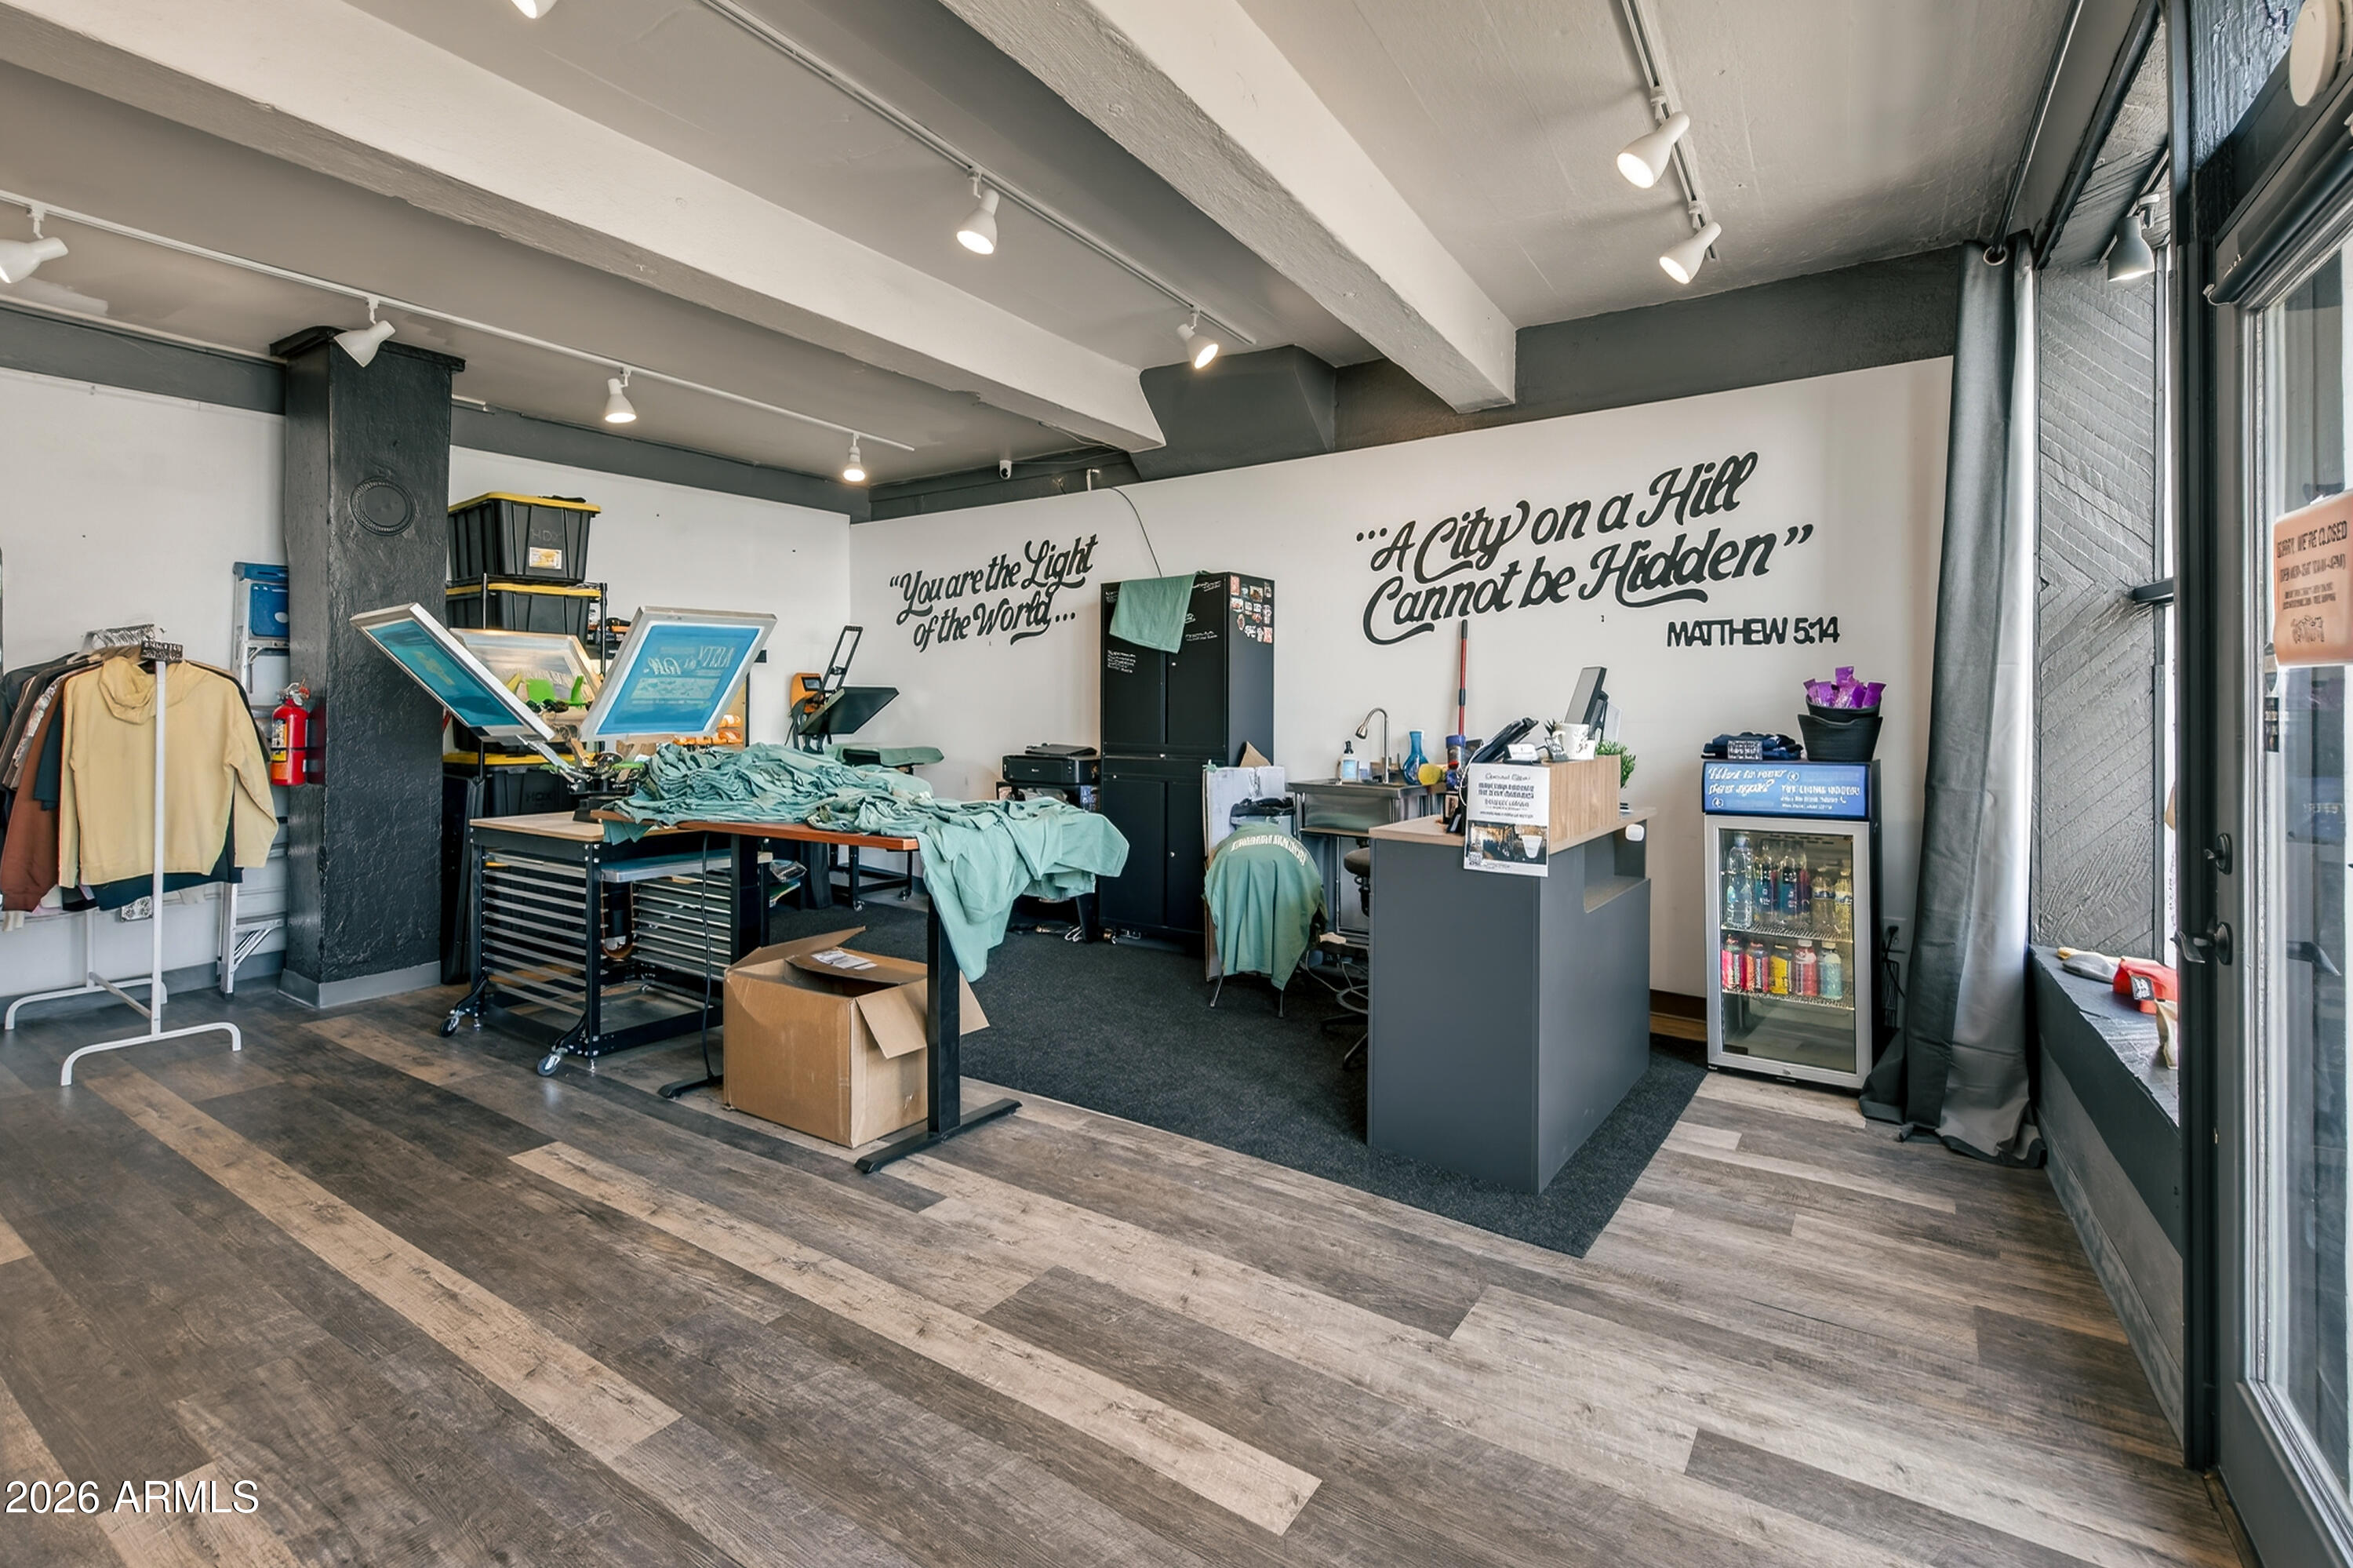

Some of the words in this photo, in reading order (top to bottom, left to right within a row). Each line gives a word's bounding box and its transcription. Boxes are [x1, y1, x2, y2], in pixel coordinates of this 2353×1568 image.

[1414, 500, 1530, 584] City
[1531, 500, 1591, 545] on
[1597, 492, 1634, 533] a
[1635, 451, 1758, 528] Hill
[944, 569, 984, 599] are
[984, 553, 1021, 592] the
[1021, 533, 1098, 589] Light
[913, 615, 938, 653] of
[937, 607, 970, 644] the
[1363, 560, 1522, 646] Cannot
[1518, 555, 1576, 609] be
[1667, 617, 1787, 647] MATTHEW
[1793, 616, 1841, 644] 5:14
